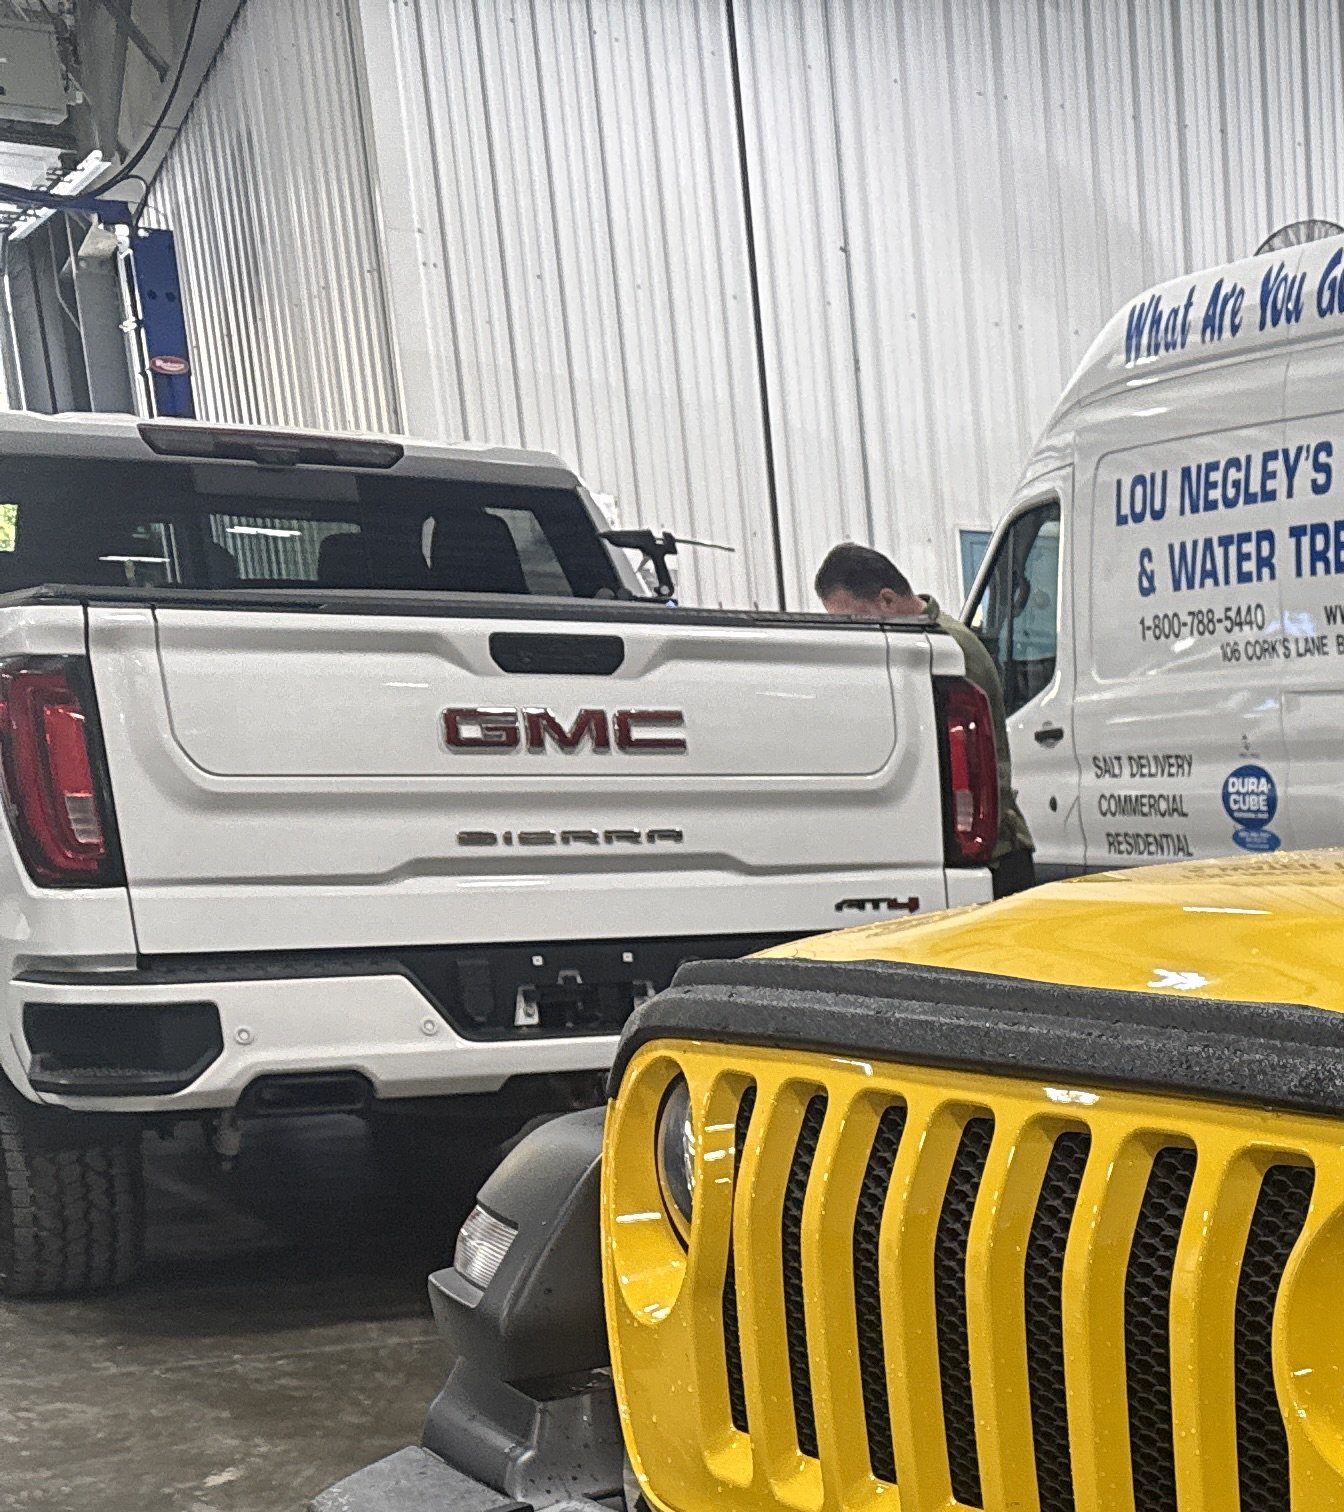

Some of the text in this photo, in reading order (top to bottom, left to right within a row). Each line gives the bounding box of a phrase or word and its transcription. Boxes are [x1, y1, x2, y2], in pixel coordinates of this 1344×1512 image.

[1125, 285, 1196, 364] What
[1201, 277, 1245, 344] Are
[1259, 260, 1307, 332] You
[1115, 470, 1168, 527] LOU
[1179, 440, 1334, 516] NEGLEY'S
[1138, 547, 1157, 597] &
[1168, 528, 1276, 593] WATER
[1138, 603, 1266, 642] 1-800-788-5440
[1220, 640, 1241, 663] 106
[1244, 637, 1292, 662] CORK'S
[1294, 635, 1329, 658] LANE
[441, 706, 688, 756] GMC
[1092, 753, 1193, 779] SALT DELIVERY
[1098, 793, 1189, 818] COMMERCIAL
[1229, 794, 1269, 811] CUBE
[456, 829, 684, 846] SIERRA
[1105, 832, 1194, 857] RESIDENTIAL
[834, 896, 920, 912] AT4
